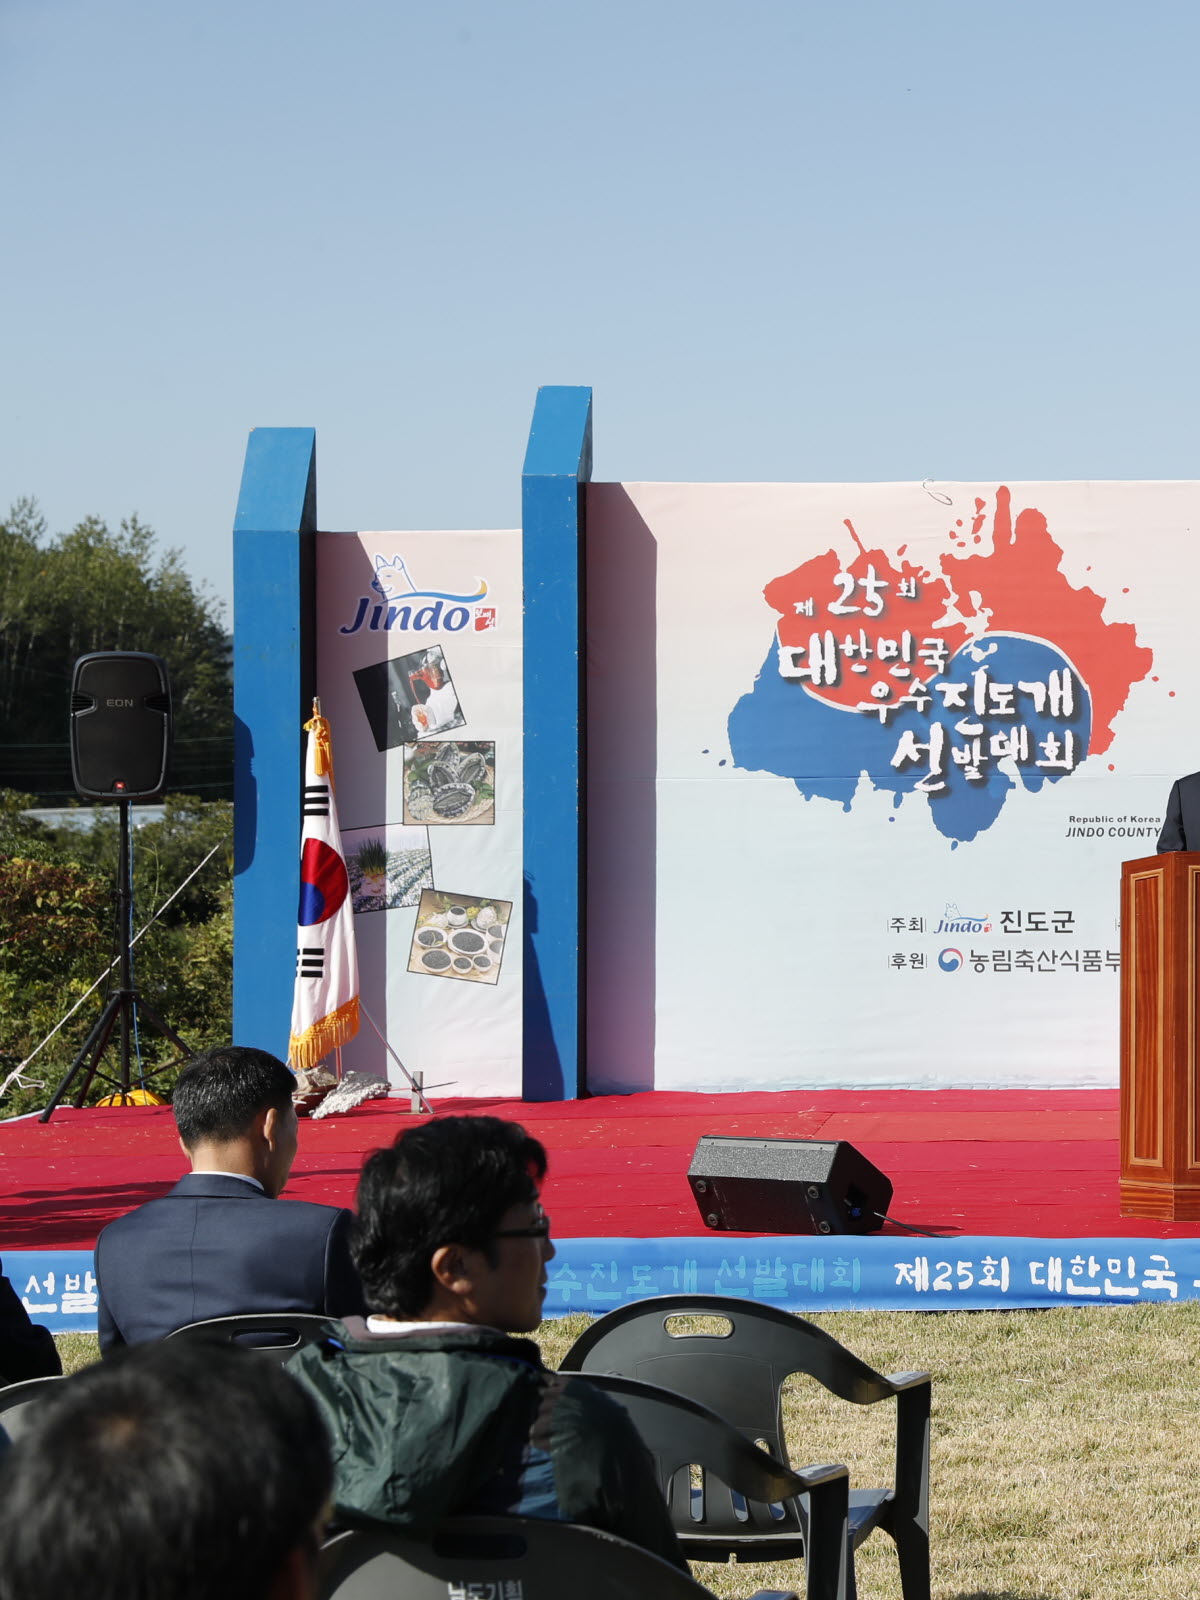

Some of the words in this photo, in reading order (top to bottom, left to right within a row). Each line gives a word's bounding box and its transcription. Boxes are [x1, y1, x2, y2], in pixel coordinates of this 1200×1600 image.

[340, 598, 470, 634] Jindo
[778, 628, 949, 686] 대한민국
[106, 698, 134, 707] EON
[857, 665, 1074, 736] 우수진도개
[890, 721, 1075, 792] 선발대회
[1069, 815, 1114, 825] Republic
[1117, 815, 1127, 823] of
[1130, 815, 1161, 823] Korea
[1065, 827, 1105, 838] JINDO
[1108, 827, 1161, 838] COUNTY
[889, 917, 923, 933] 주최
[933, 918, 983, 934] Jindo
[999, 910, 1075, 934] 진도군
[890, 953, 924, 969] 후원
[969, 949, 1120, 974] 농림축산식품부
[714, 1257, 861, 1298] 선발대회
[894, 1255, 1010, 1292] 제25회
[1029, 1254, 1178, 1299] 대한민국
[21, 1271, 98, 1314] 선발
